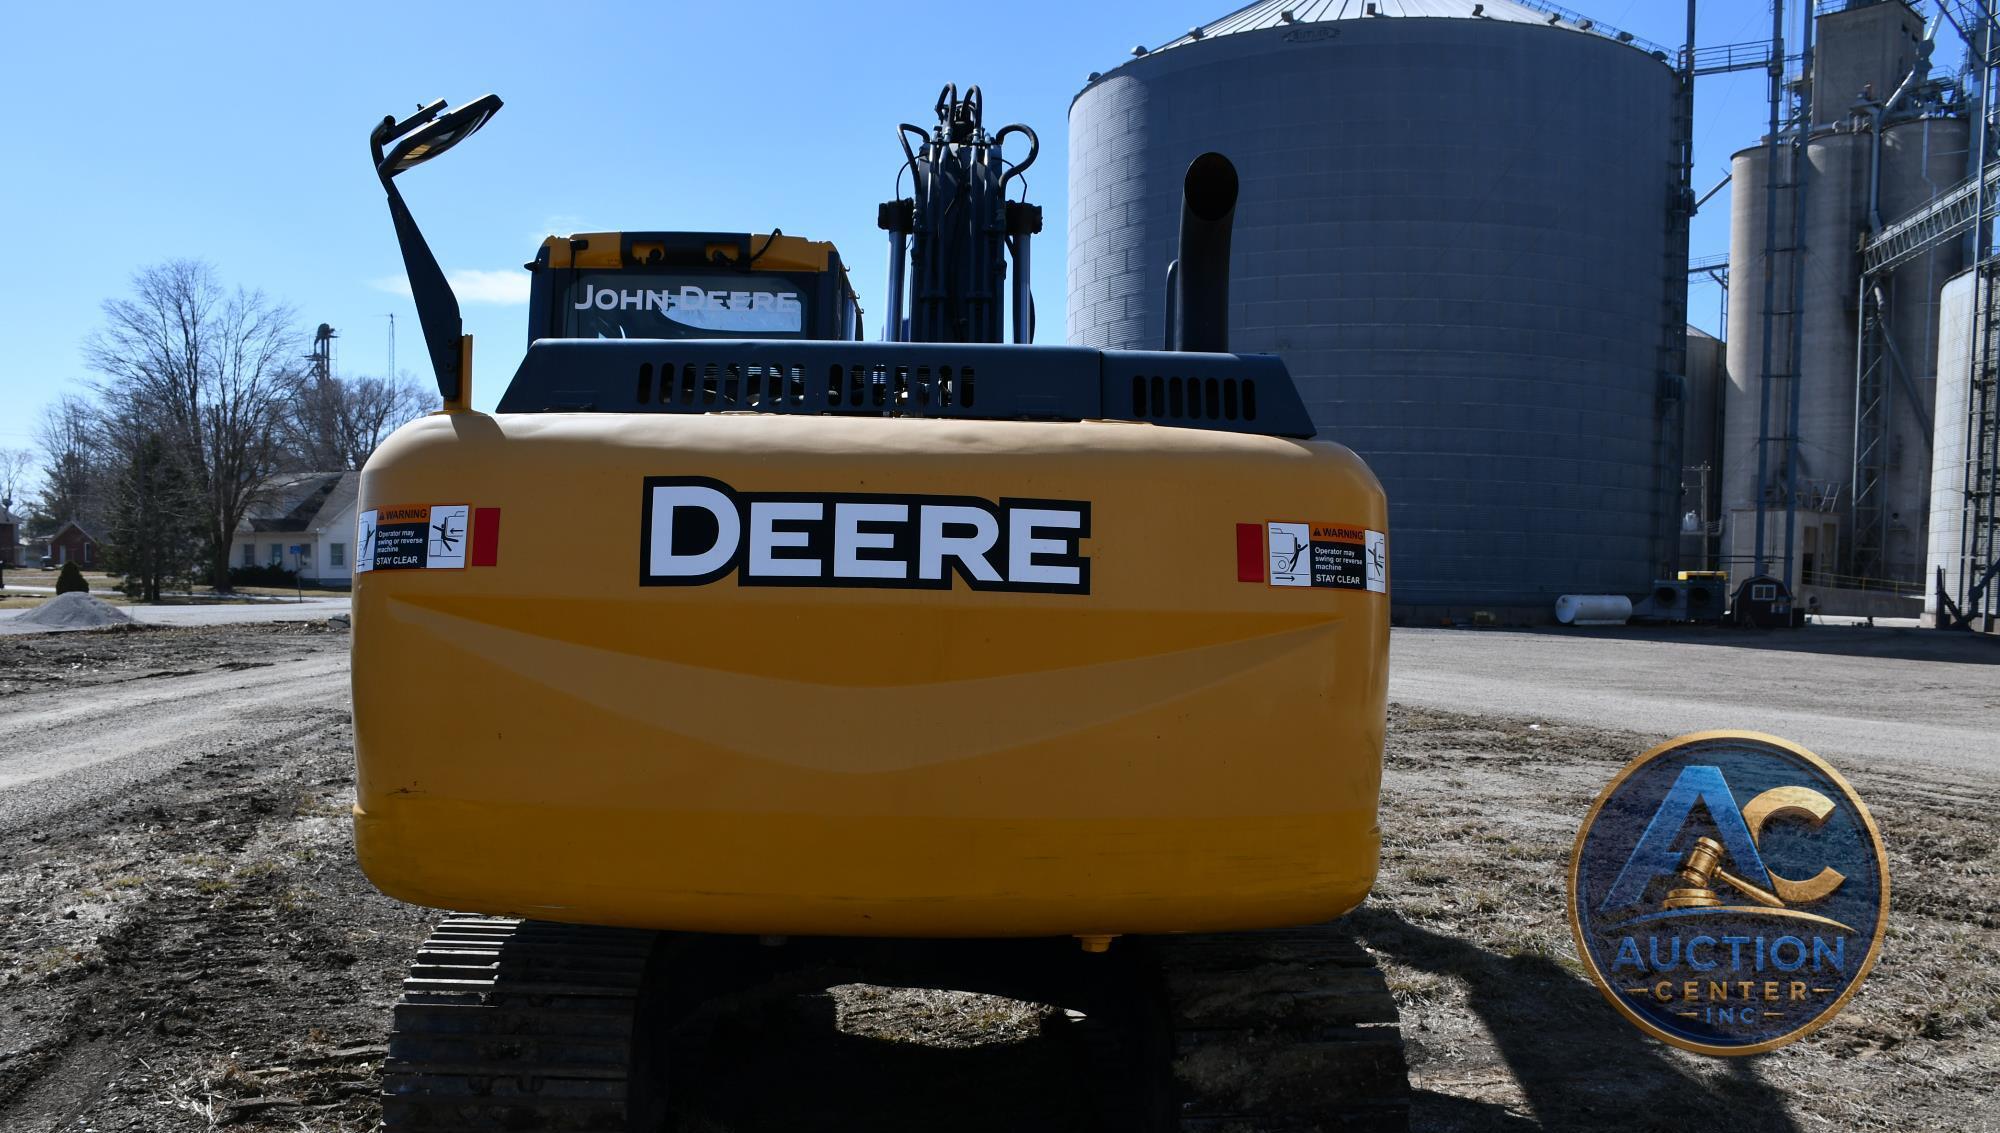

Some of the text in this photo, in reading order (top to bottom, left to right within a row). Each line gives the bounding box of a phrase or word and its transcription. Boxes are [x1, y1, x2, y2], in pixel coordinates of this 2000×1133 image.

[574, 284, 799, 313] JOHN DEERE
[386, 509, 427, 519] WARNING
[378, 530, 400, 538] Operator
[649, 485, 1082, 585] DEERE
[1323, 528, 1363, 540] WARNING
[378, 539, 393, 547] swing
[1315, 547, 1342, 557] Operator
[376, 556, 418, 565] STAY CLEAR
[1315, 556, 1334, 564] swing
[1316, 575, 1360, 584] STAY CLEAR
